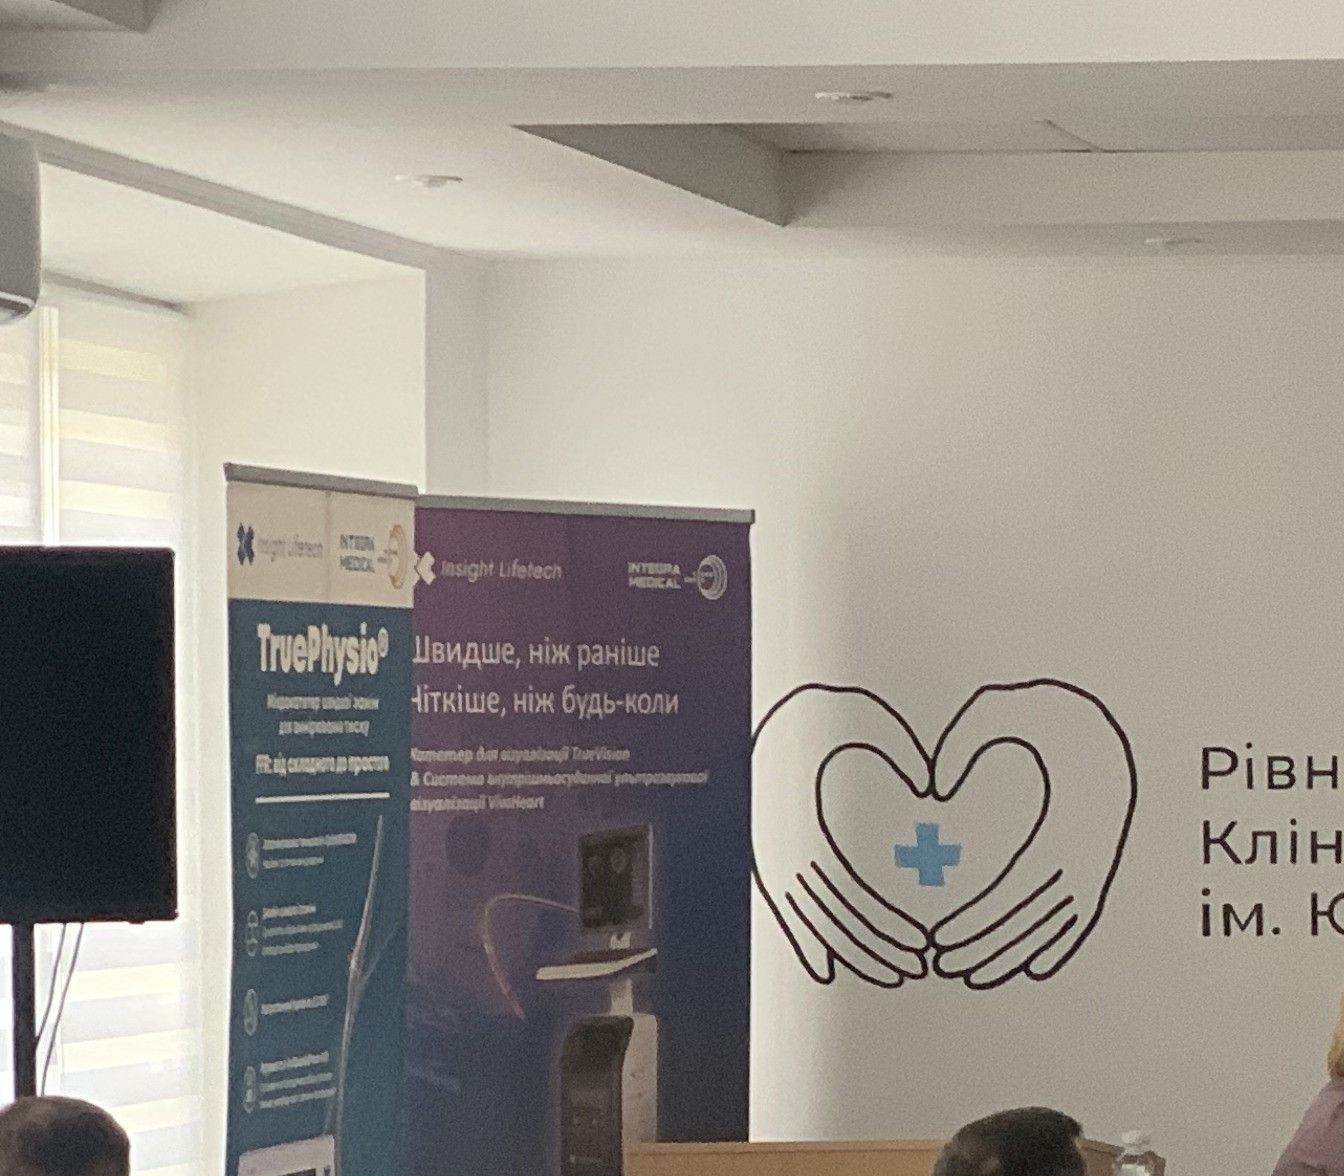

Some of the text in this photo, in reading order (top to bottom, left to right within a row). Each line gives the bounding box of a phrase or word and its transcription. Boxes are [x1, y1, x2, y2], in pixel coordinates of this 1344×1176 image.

[441, 559, 562, 583] Insight Lifetech
[628, 577, 682, 590] MEDICAL
[529, 637, 571, 665] ніж
[578, 638, 661, 672] раніше
[513, 685, 555, 715] ніж
[562, 685, 679, 720] будь-коли
[1201, 887, 1281, 938] ім.
